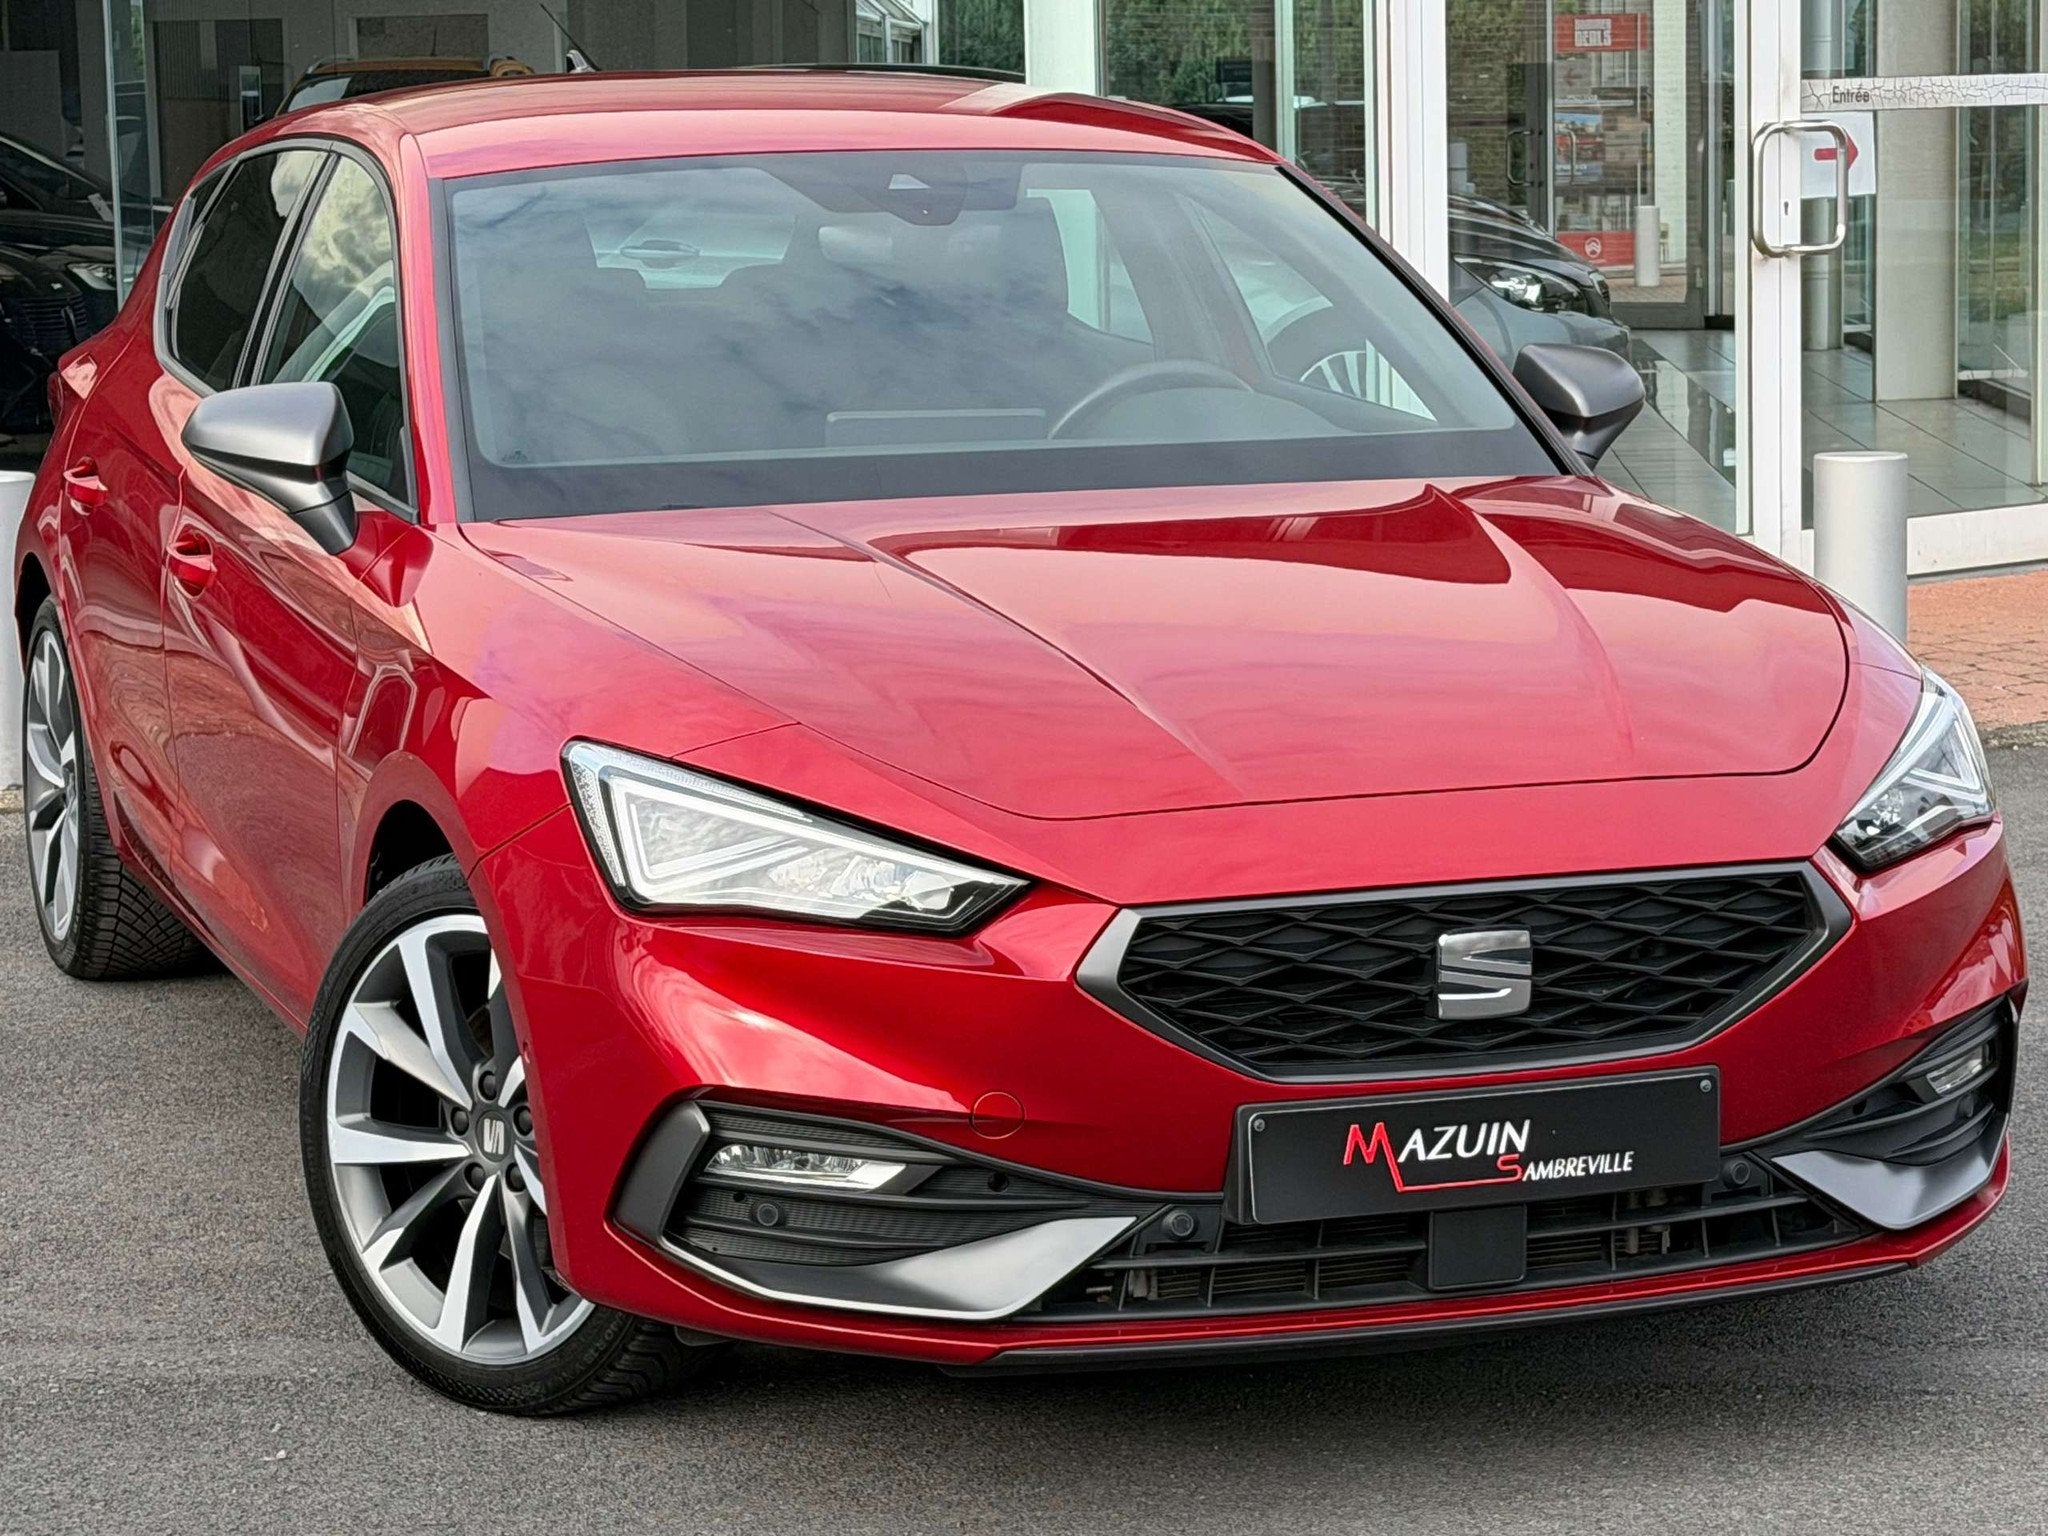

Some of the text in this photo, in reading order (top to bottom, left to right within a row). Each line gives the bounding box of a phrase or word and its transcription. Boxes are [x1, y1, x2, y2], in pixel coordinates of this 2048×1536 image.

[1832, 85, 1870, 103] Entrée
[1343, 1119, 1530, 1167] MAZUIN
[1496, 1151, 1635, 1183] SAMBREVILLE
